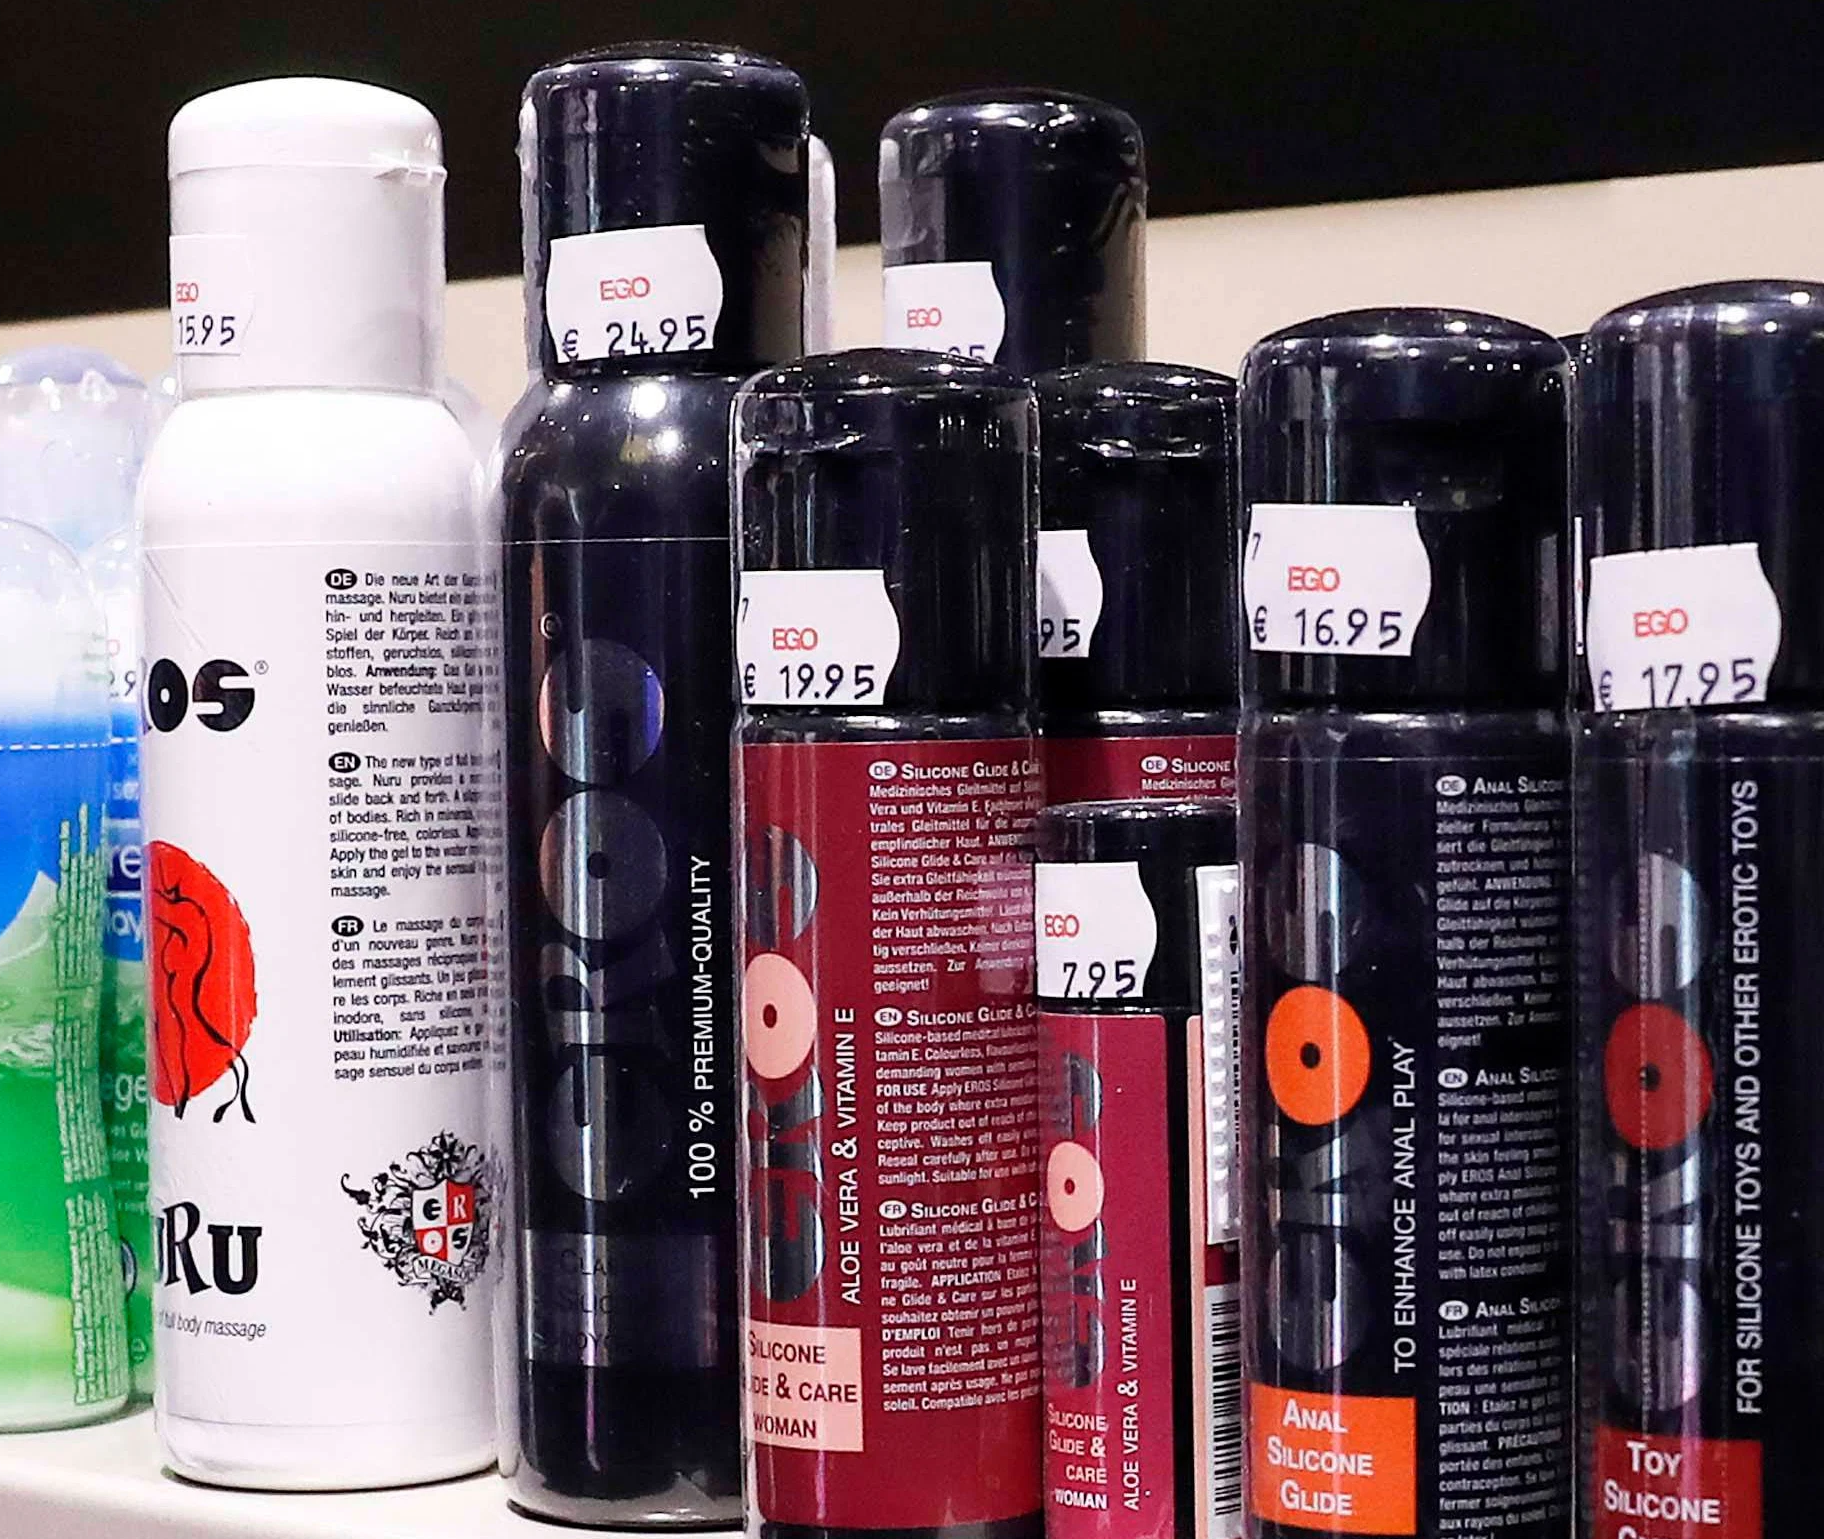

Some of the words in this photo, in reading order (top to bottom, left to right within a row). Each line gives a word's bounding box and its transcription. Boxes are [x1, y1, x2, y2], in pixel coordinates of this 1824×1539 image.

[175, 283, 200, 302] EGO
[600, 276, 650, 301] EGO
[907, 307, 942, 328] EGO
[178, 315, 237, 346] 15.95
[605, 314, 707, 354] 24.95
[1287, 567, 1341, 591] EGO
[360, 610, 382, 623] und
[1253, 607, 1267, 643] €
[1294, 609, 1403, 647] 16.95
[1633, 609, 1689, 638] EGO
[326, 628, 357, 642] Spiel
[365, 628, 385, 641] der
[773, 627, 818, 651] EGO
[326, 647, 374, 661] stoffen,
[327, 683, 373, 697] Wasser
[779, 664, 875, 699] 19.95
[1641, 659, 1756, 706] 17.95
[146, 657, 255, 733] OS
[1171, 756, 1231, 772] SILICONE
[373, 774, 401, 786] Nuru
[870, 785, 952, 797] Medizinisches
[1473, 777, 1514, 795] ANAL
[329, 793, 359, 806] slide
[365, 792, 394, 805] back
[400, 792, 420, 804] and
[348, 810, 391, 823] bodies.
[1732, 778, 1758, 856] TOYS
[330, 848, 365, 863] Apply
[331, 866, 357, 879] skin
[363, 866, 385, 878] and
[331, 886, 390, 898] massage.
[1045, 915, 1078, 936] EGO
[1733, 862, 1758, 966] EROTIC
[363, 956, 421, 970] massages
[691, 855, 713, 1090] PREMIUM-QUALITY
[1063, 960, 1136, 997] 7.95
[835, 1008, 855, 1023] E
[907, 1010, 973, 1026] SILICONE
[1734, 973, 1760, 1068] OTHER
[875, 1030, 960, 1044] Silicone-based
[835, 1033, 857, 1129] VITAMIN
[876, 1067, 941, 1080] demanding
[1393, 1041, 1416, 1124] PLAY
[1475, 1069, 1515, 1087] ANAL
[877, 1084, 901, 1096] FOR
[903, 1083, 927, 1096] USE
[931, 1082, 962, 1097] Apply
[688, 1101, 715, 1132] %
[917, 1101, 945, 1115] body
[1735, 1075, 1761, 1134] AND
[877, 1119, 907, 1132] Keep
[911, 1118, 955, 1133] product
[832, 1137, 857, 1158] &
[689, 1143, 715, 1198] 100
[1393, 1128, 1416, 1204] ANAL
[1735, 1142, 1761, 1217] TOYS
[839, 1168, 858, 1232] VERA
[911, 1203, 978, 1218] SILICONE
[880, 1224, 936, 1237] Lubrifiant
[841, 1241, 861, 1304] ALOE
[932, 1256, 968, 1270] neutre
[1394, 1207, 1417, 1330] ENHANCE
[932, 1271, 1001, 1287] APPLICATION
[1121, 1279, 1136, 1292] E
[1736, 1225, 1763, 1351] SILICONE
[1476, 1302, 1515, 1318] ANAL
[177, 1312, 202, 1337] body
[204, 1319, 267, 1341] massage
[1121, 1299, 1138, 1372] VITAMIN
[883, 1346, 925, 1360] produit
[1394, 1335, 1417, 1374] TO
[799, 1382, 857, 1402] CARE
[1117, 1380, 1138, 1396] &
[1737, 1357, 1762, 1415] FOR
[753, 1412, 816, 1439] WOMAN
[1048, 1403, 1106, 1431] SILICONE
[1282, 1397, 1348, 1433] ANAL
[1123, 1404, 1139, 1454] VERA
[1049, 1430, 1085, 1455] GLIDE
[1090, 1436, 1106, 1458] &
[1267, 1437, 1374, 1476] SILICONE
[1626, 1440, 1684, 1478] TOY
[1066, 1465, 1107, 1484] CARE
[1123, 1461, 1139, 1510] ALOE
[1055, 1488, 1107, 1509] WOMAN
[1279, 1478, 1353, 1517] GLIDE
[1603, 1479, 1721, 1525] SILICONE
